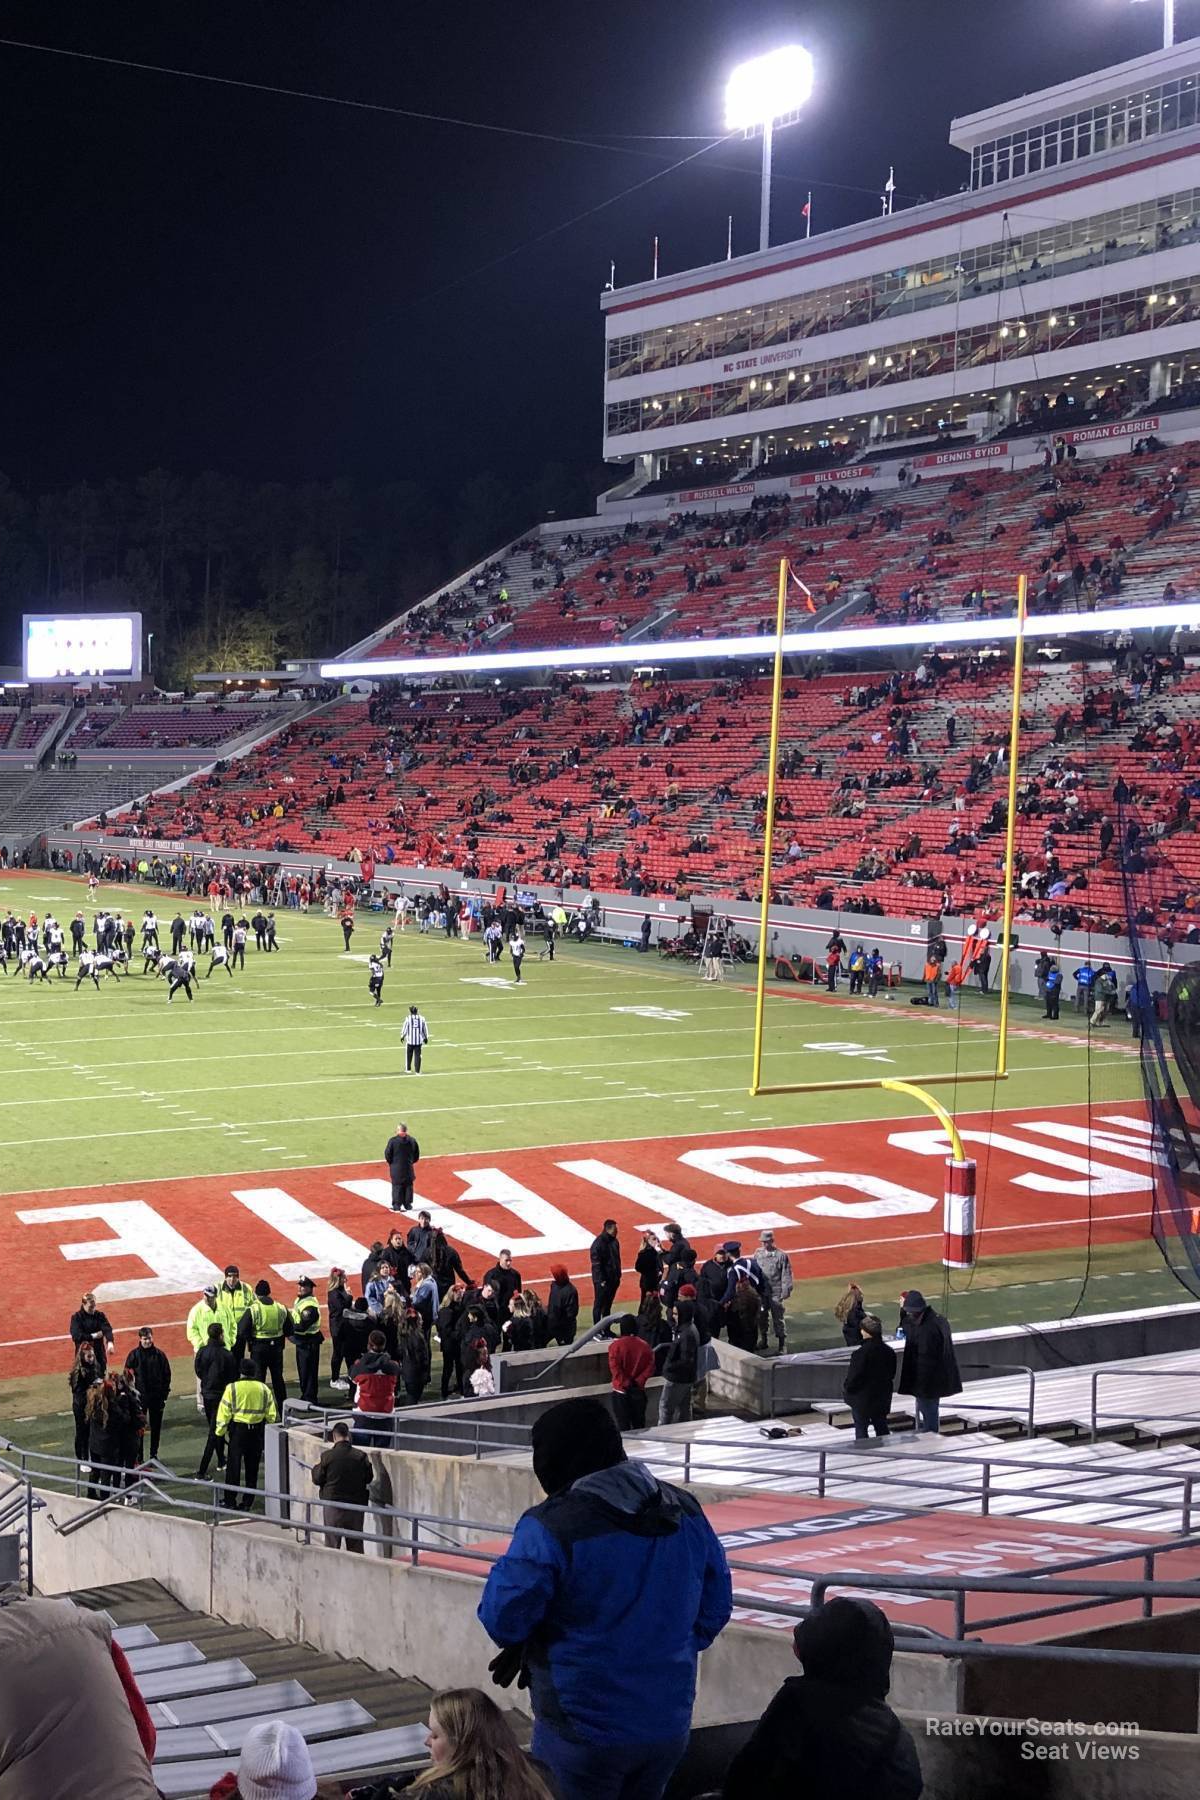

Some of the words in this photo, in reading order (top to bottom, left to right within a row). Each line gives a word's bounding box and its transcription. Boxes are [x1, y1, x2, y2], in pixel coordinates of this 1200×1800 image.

[723, 363, 734, 373] NC
[736, 357, 758, 370] STATE
[760, 348, 803, 365] UNIVERSITY
[1073, 429, 1109, 443] ROMAN
[1112, 419, 1158, 437] GABRIEL
[936, 451, 972, 465] DENNIS
[974, 446, 1001, 459] BYRD
[814, 473, 833, 483] BILL
[835, 467, 863, 480] YOEST
[693, 487, 725, 500] RUSSELL
[726, 484, 755, 496] WILSON
[15, 1145, 938, 1304] STATE
